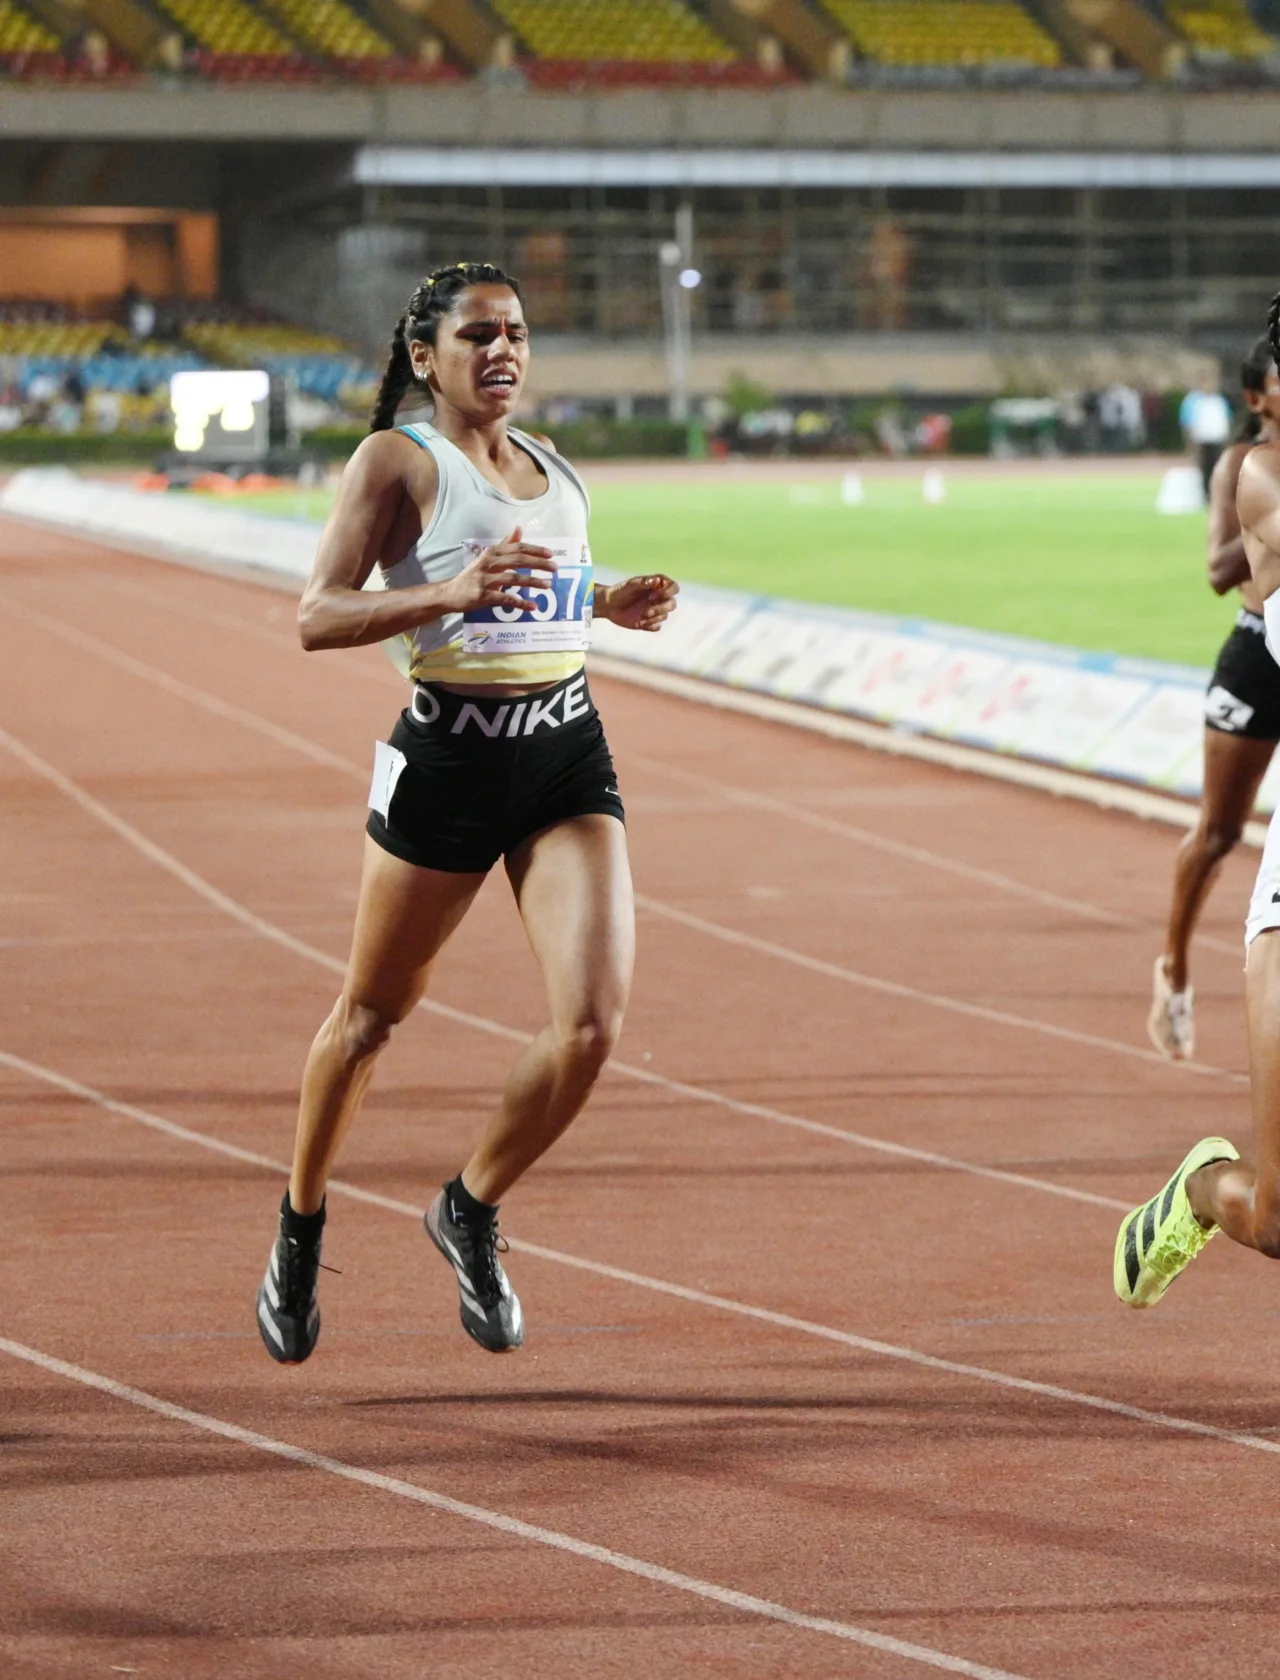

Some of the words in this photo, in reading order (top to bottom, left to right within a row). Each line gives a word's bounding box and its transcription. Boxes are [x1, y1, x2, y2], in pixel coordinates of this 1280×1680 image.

[491, 568, 582, 623] 357
[497, 631, 527, 639] INDIAN
[450, 674, 590, 738] NIKE
